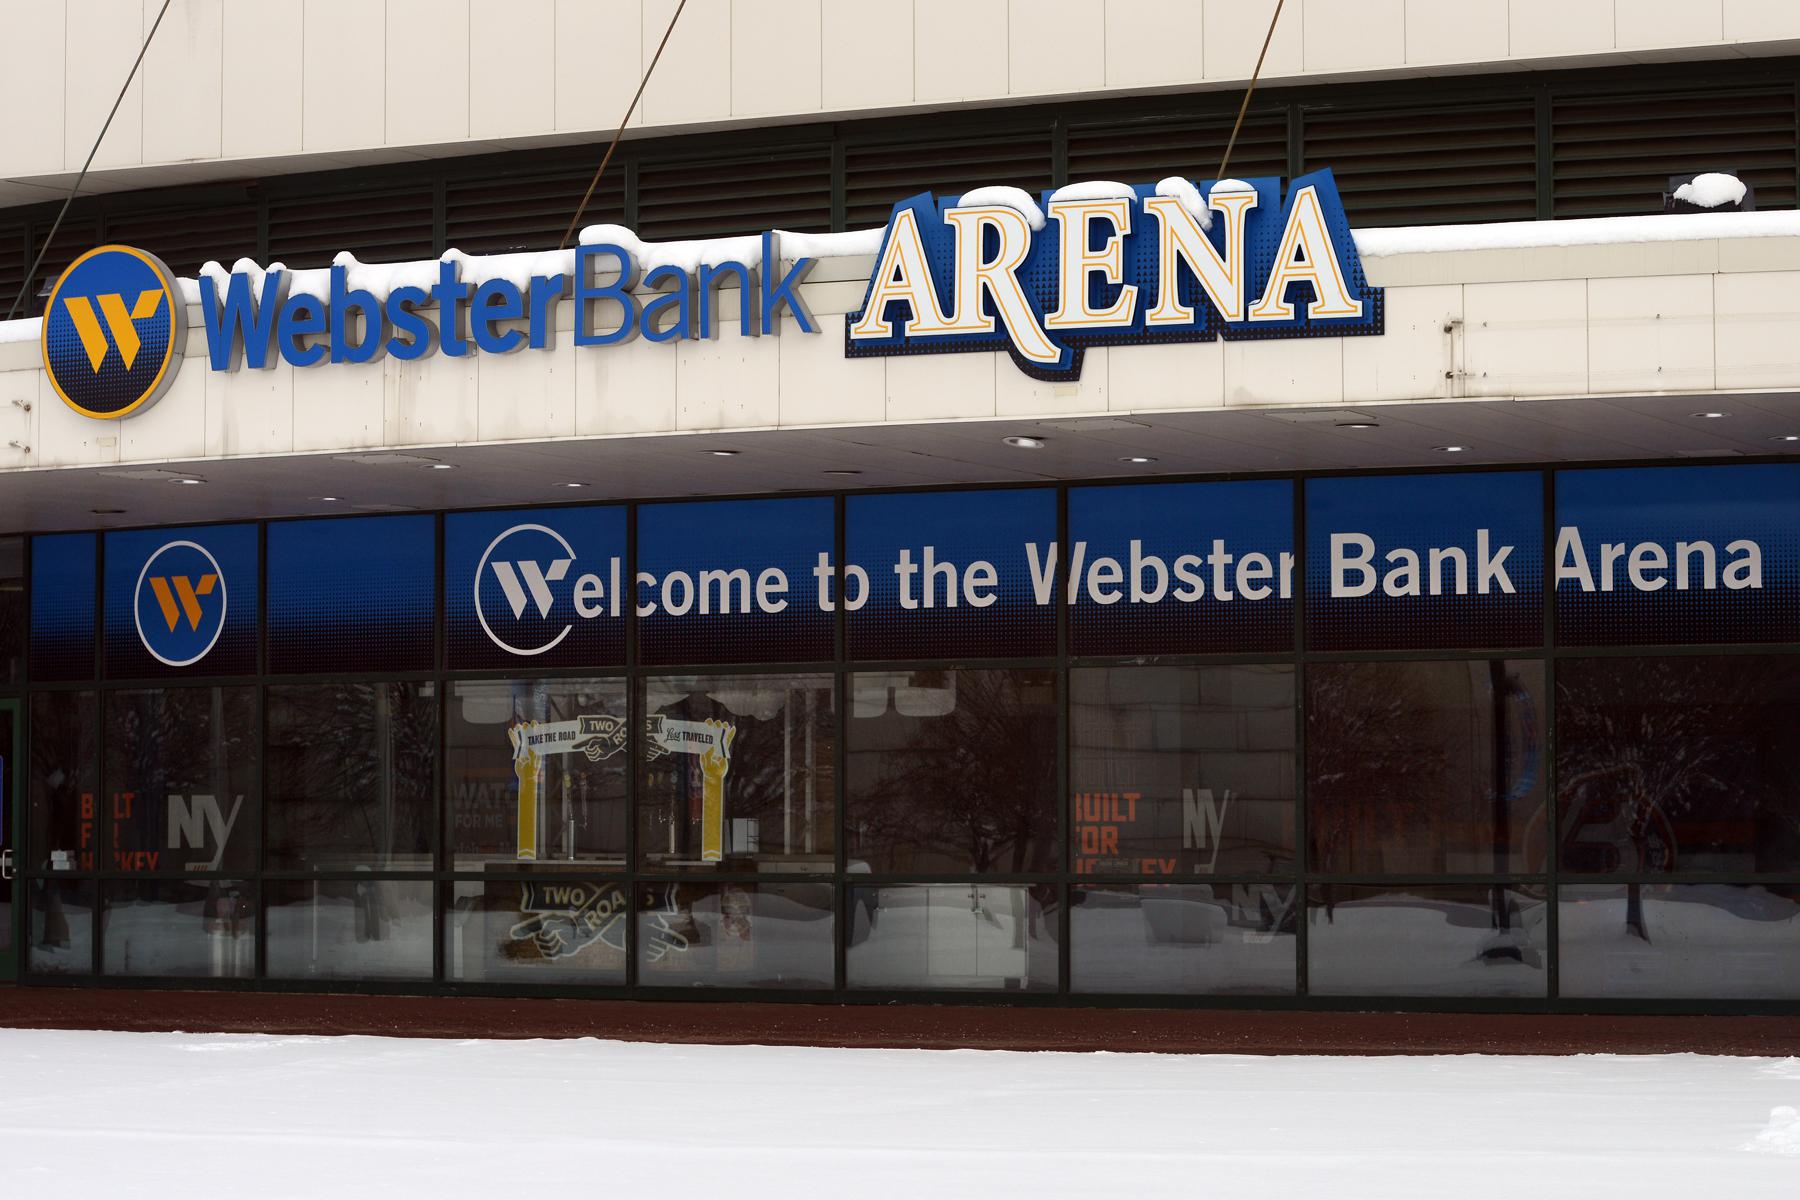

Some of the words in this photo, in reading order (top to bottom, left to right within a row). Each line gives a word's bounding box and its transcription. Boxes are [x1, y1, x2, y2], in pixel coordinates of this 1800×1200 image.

[851, 185, 1363, 364] ARENA
[491, 555, 789, 622] Welcome
[813, 551, 870, 612] to
[894, 545, 999, 610] the
[1025, 538, 1295, 606] Webster
[1330, 528, 1518, 599] Bank
[1553, 526, 1764, 592] Arena
[589, 720, 614, 732] TWO
[528, 735, 544, 746] TAKE
[545, 733, 557, 744] THE
[558, 731, 576, 742] ROAD
[682, 732, 714, 745] TRAVELED
[1075, 825, 1119, 857] OR
[543, 886, 586, 907] TWO
